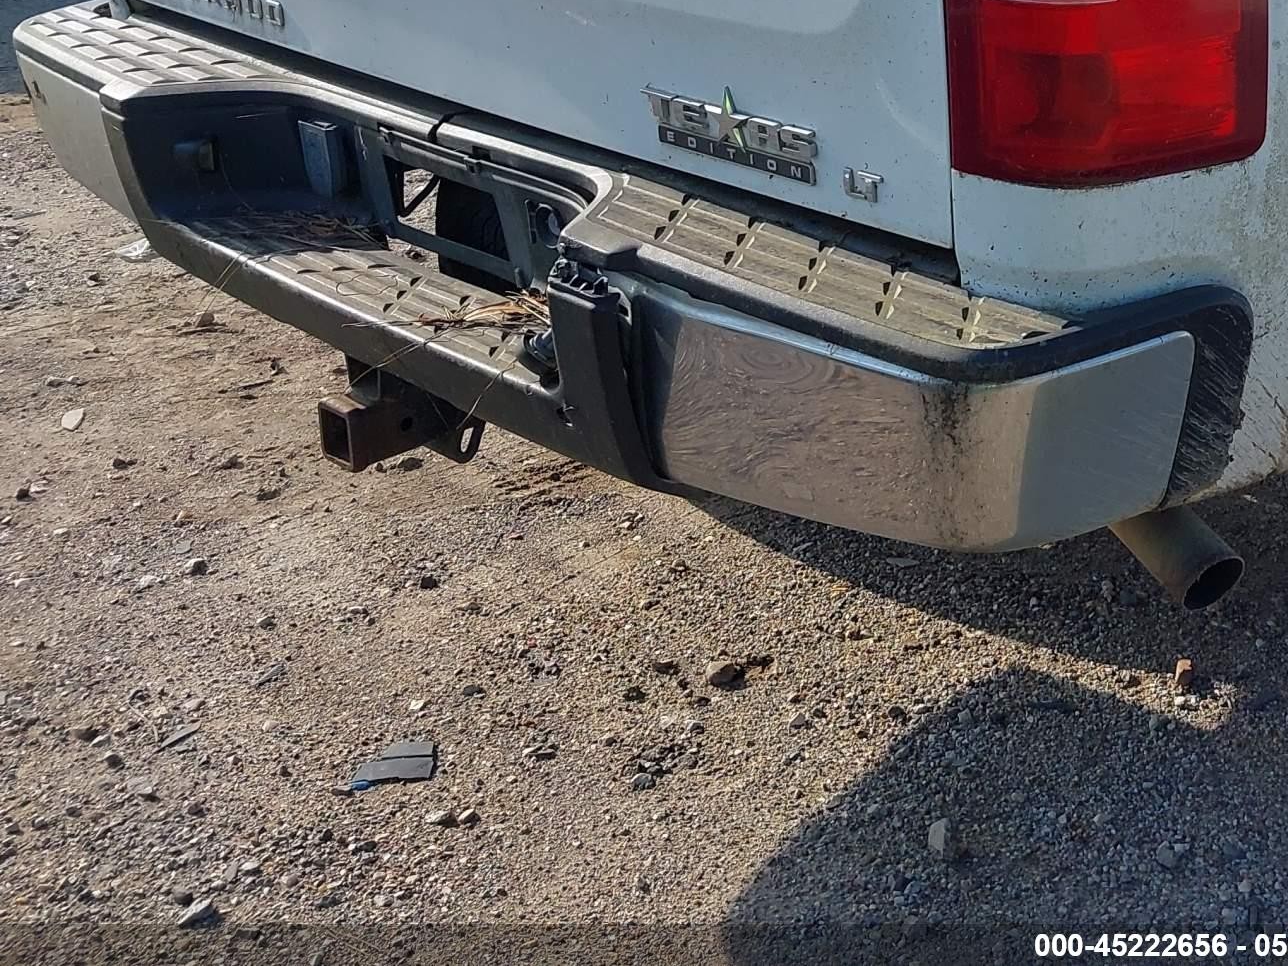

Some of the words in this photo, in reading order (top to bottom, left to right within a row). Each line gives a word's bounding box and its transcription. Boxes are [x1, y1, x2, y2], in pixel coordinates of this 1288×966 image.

[639, 84, 818, 159] TEXAS
[666, 130, 803, 180] EDITION
[843, 166, 884, 204] LT
